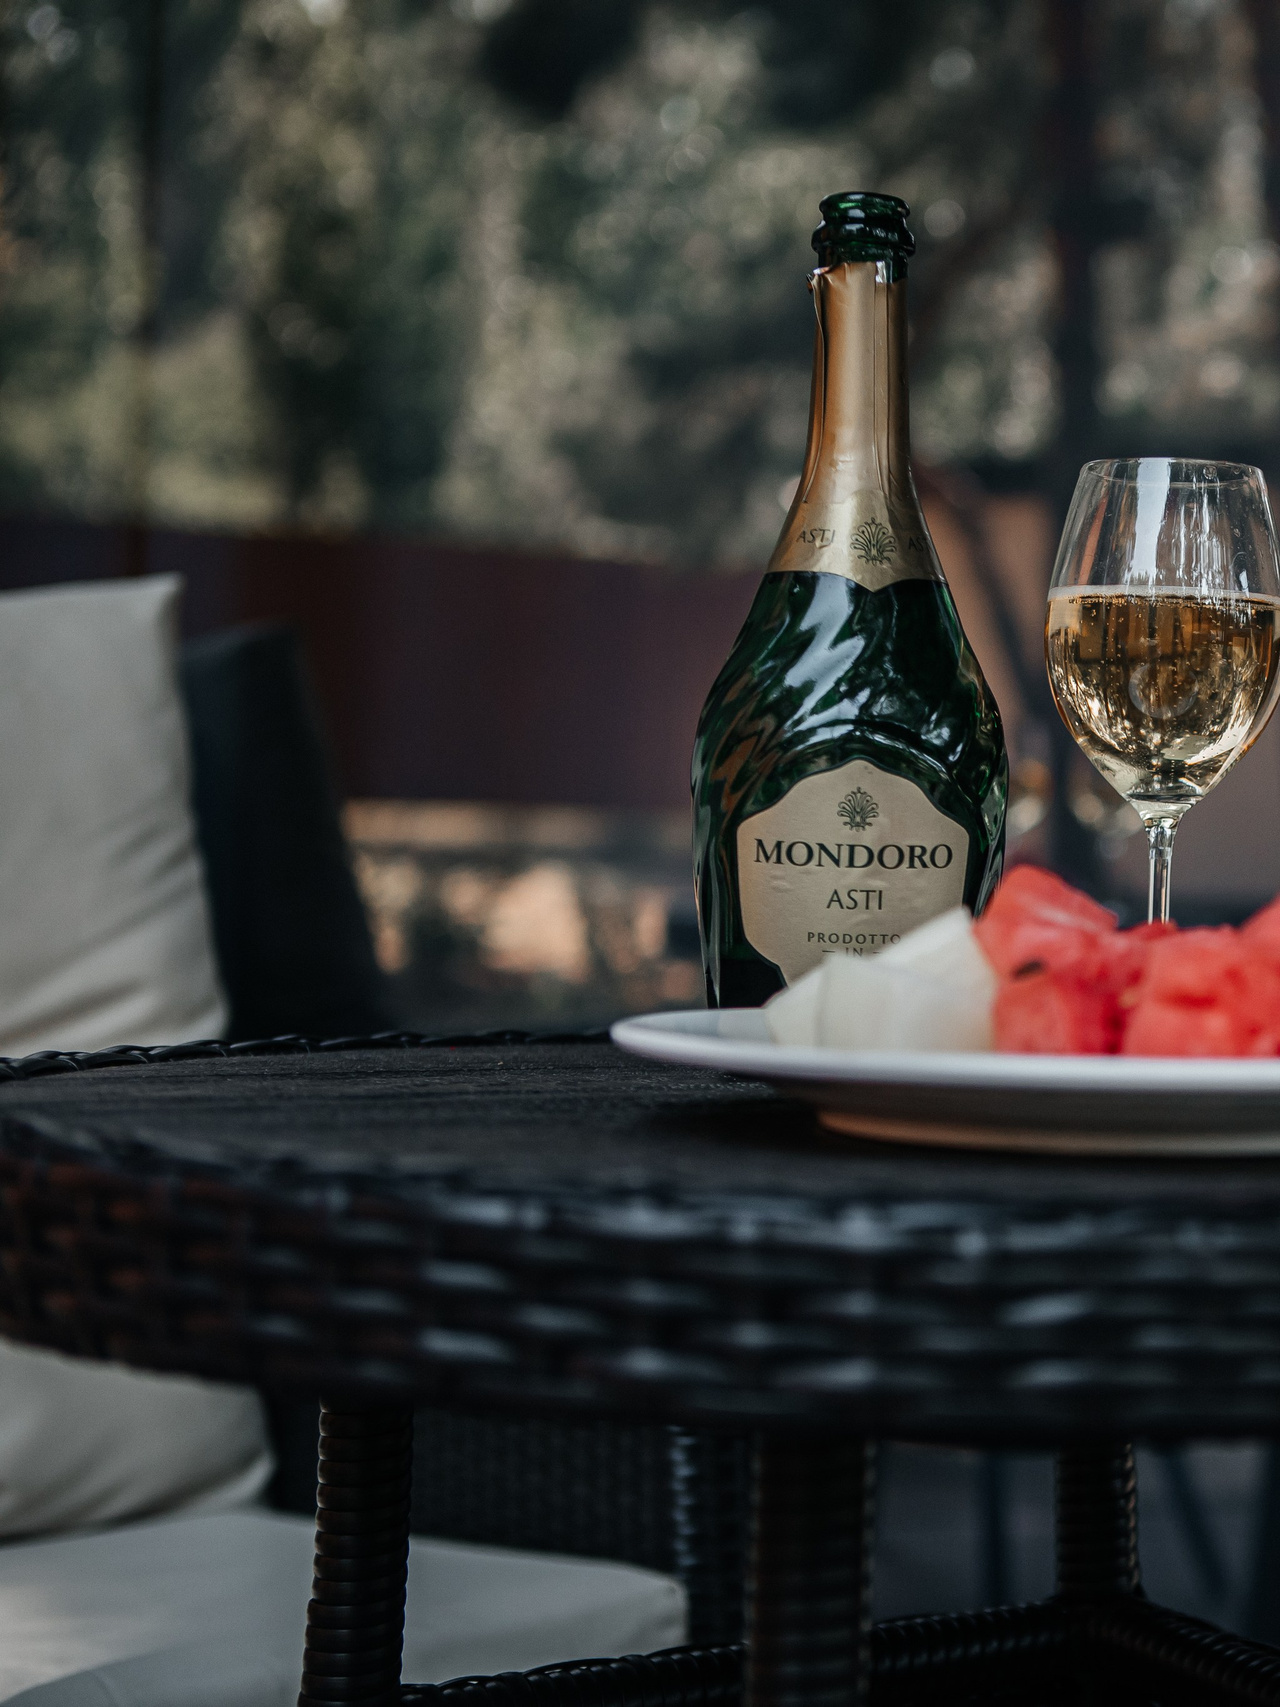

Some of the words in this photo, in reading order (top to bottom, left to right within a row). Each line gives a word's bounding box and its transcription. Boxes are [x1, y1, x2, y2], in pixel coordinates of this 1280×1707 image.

[796, 528, 836, 544] ASTI
[754, 838, 953, 870] MONDORO
[826, 889, 883, 911] ASTI
[807, 931, 901, 945] PRODOTTO
[845, 947, 864, 958] IN
